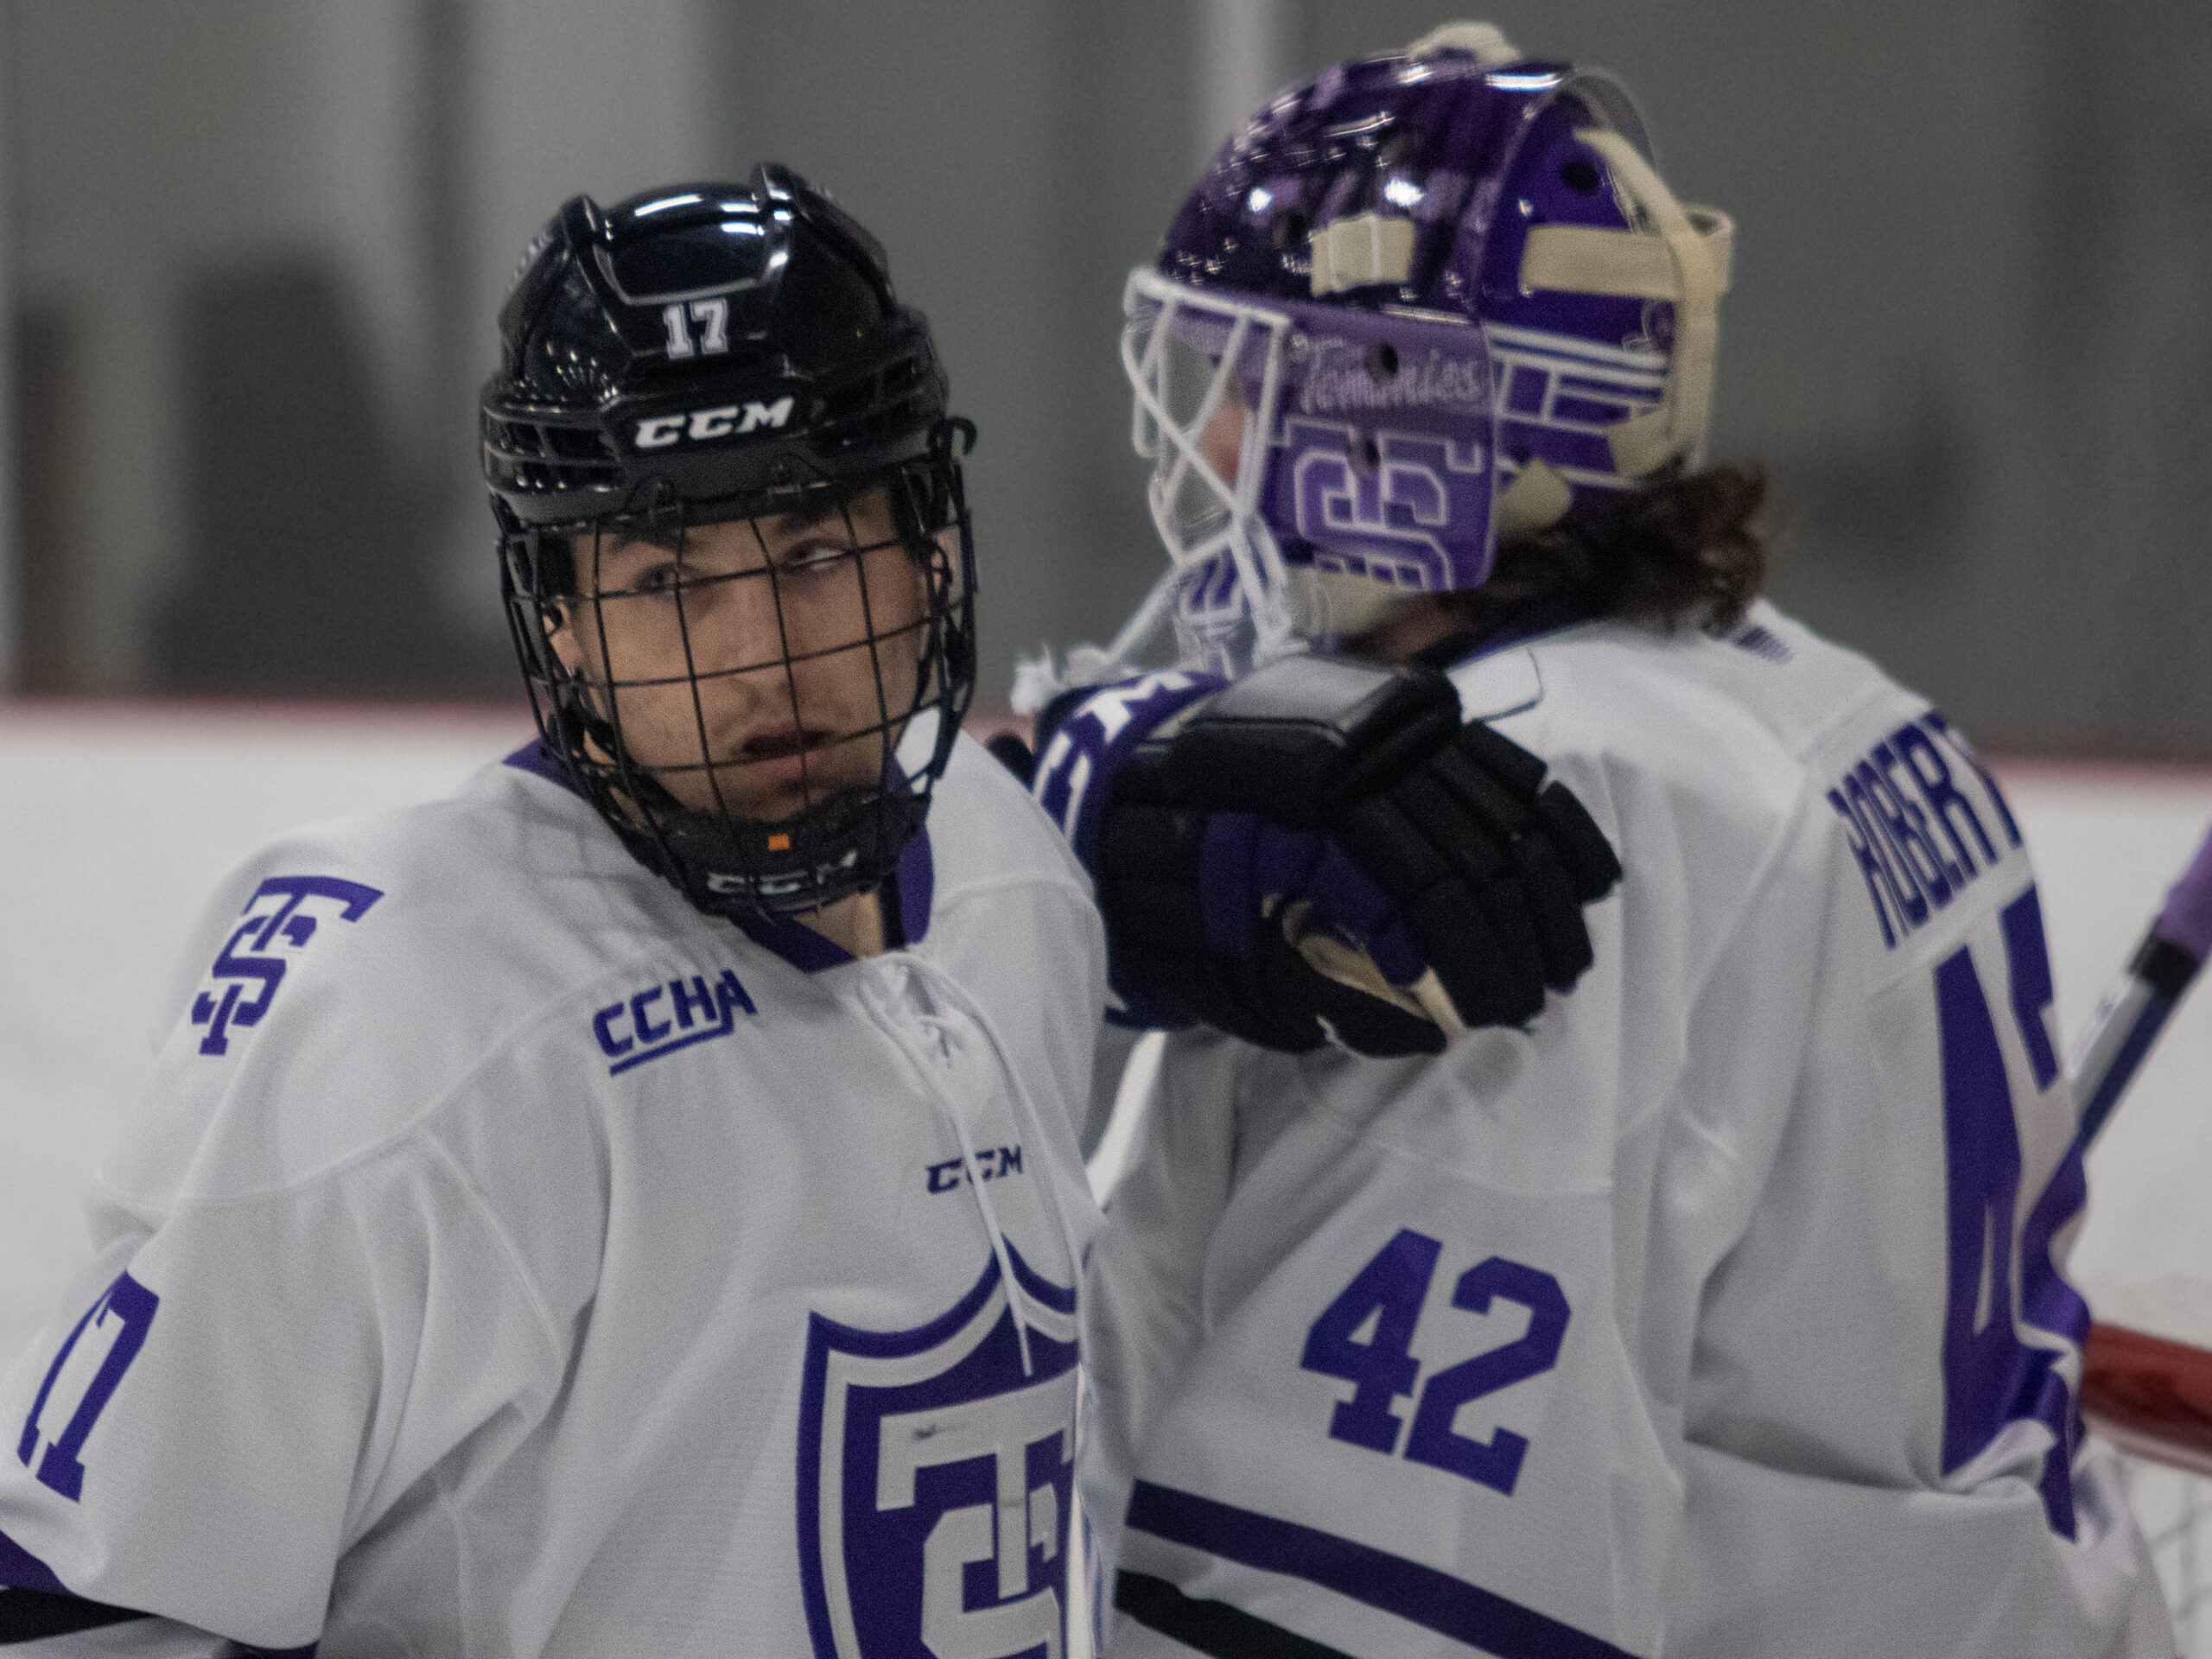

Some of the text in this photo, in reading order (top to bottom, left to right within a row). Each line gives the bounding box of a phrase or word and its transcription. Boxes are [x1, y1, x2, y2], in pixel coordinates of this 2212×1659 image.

[664, 298, 728, 359] 17
[635, 397, 794, 448] CCM
[594, 969, 757, 1075] CCHA
[926, 1144, 1024, 1194] CCM
[1301, 1228, 1570, 1495] 42
